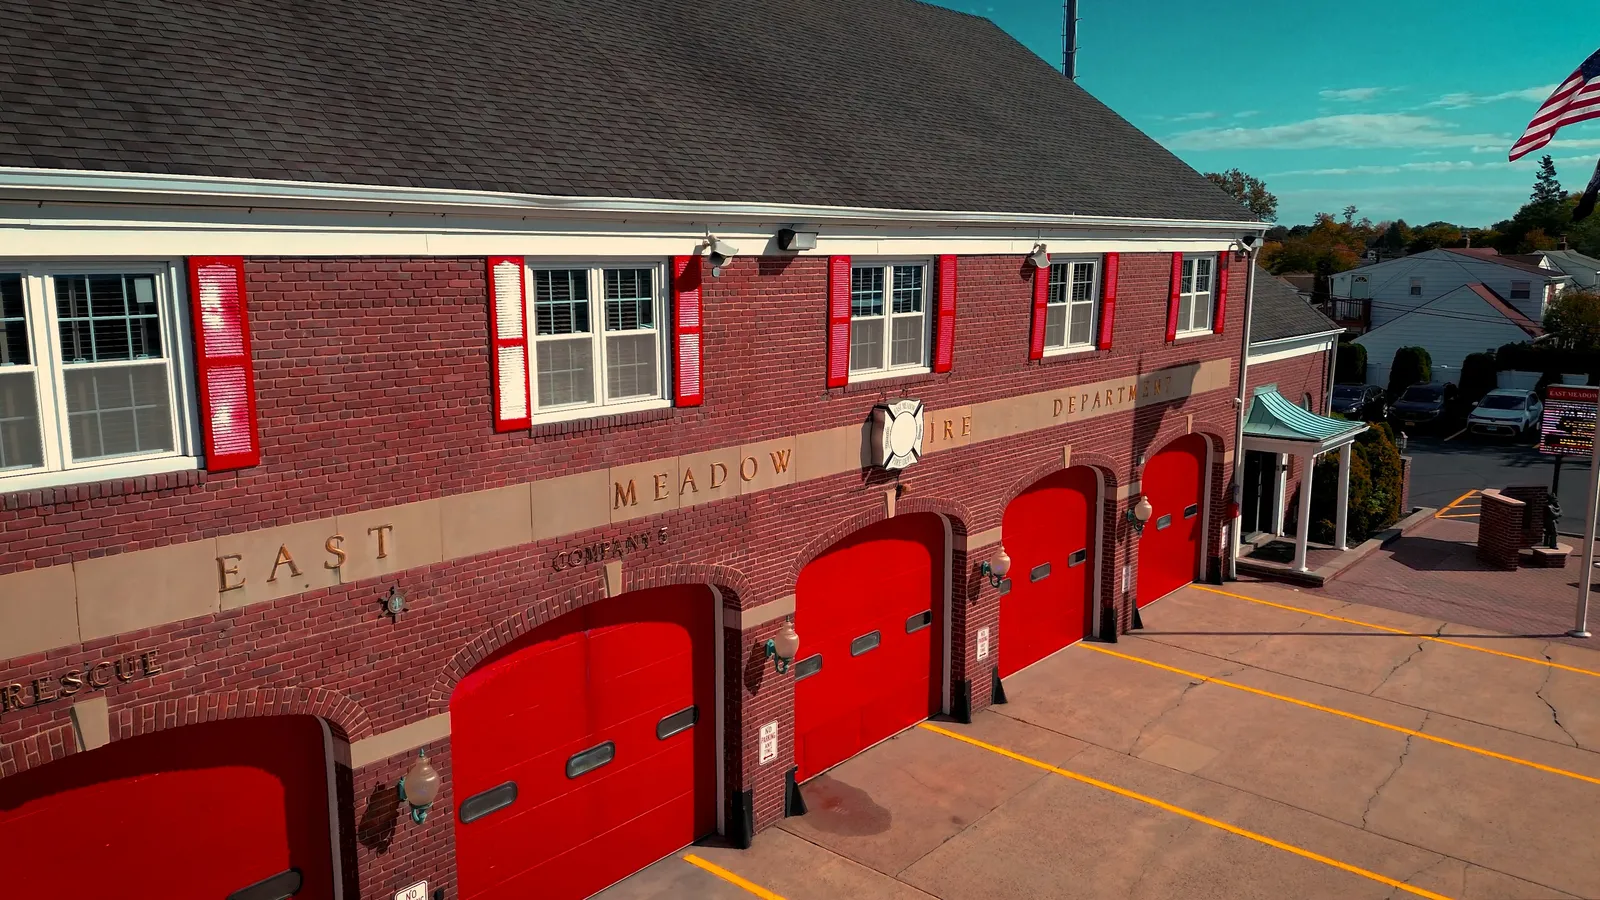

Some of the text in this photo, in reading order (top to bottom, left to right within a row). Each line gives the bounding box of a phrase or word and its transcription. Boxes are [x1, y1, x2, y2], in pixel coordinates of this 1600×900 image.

[214, 523, 393, 593] EAST
[613, 449, 792, 510] MEADOW
[929, 416, 971, 443] IRE
[1052, 376, 1172, 417] DEPARTMENT
[553, 526, 668, 572] COMPANY 5
[2, 649, 162, 710] RESCUE
[405, 889, 417, 900] NO
